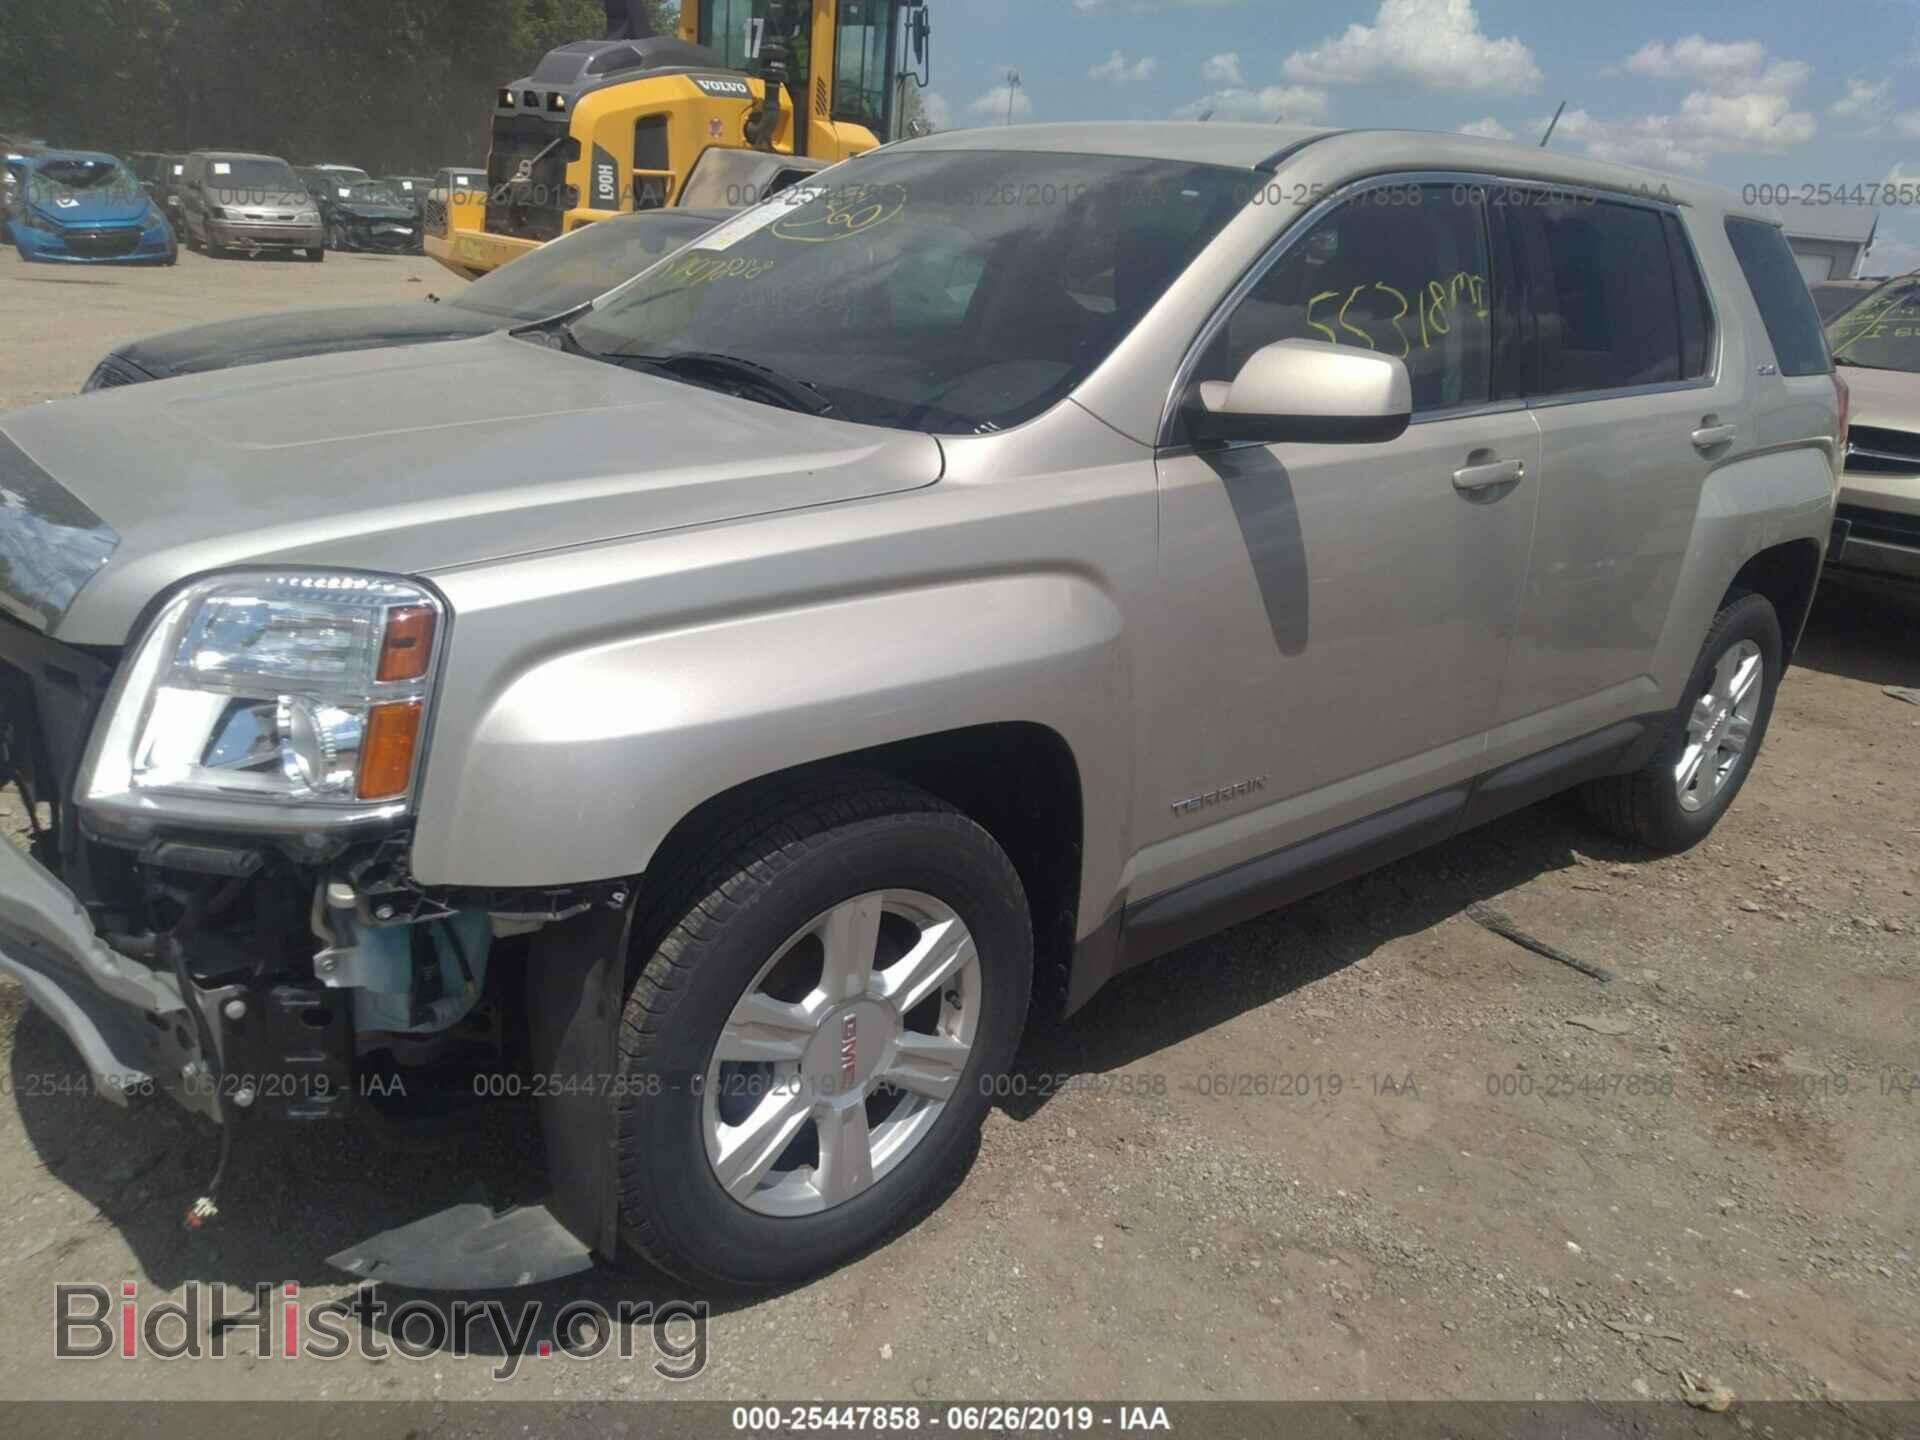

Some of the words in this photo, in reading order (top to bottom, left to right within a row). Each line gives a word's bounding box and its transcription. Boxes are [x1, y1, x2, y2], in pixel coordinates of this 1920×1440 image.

[744, 18, 765, 58] 17
[697, 79, 748, 93] VOLVO
[598, 164, 615, 200] L90H
[840, 1012, 858, 1089] GMC
